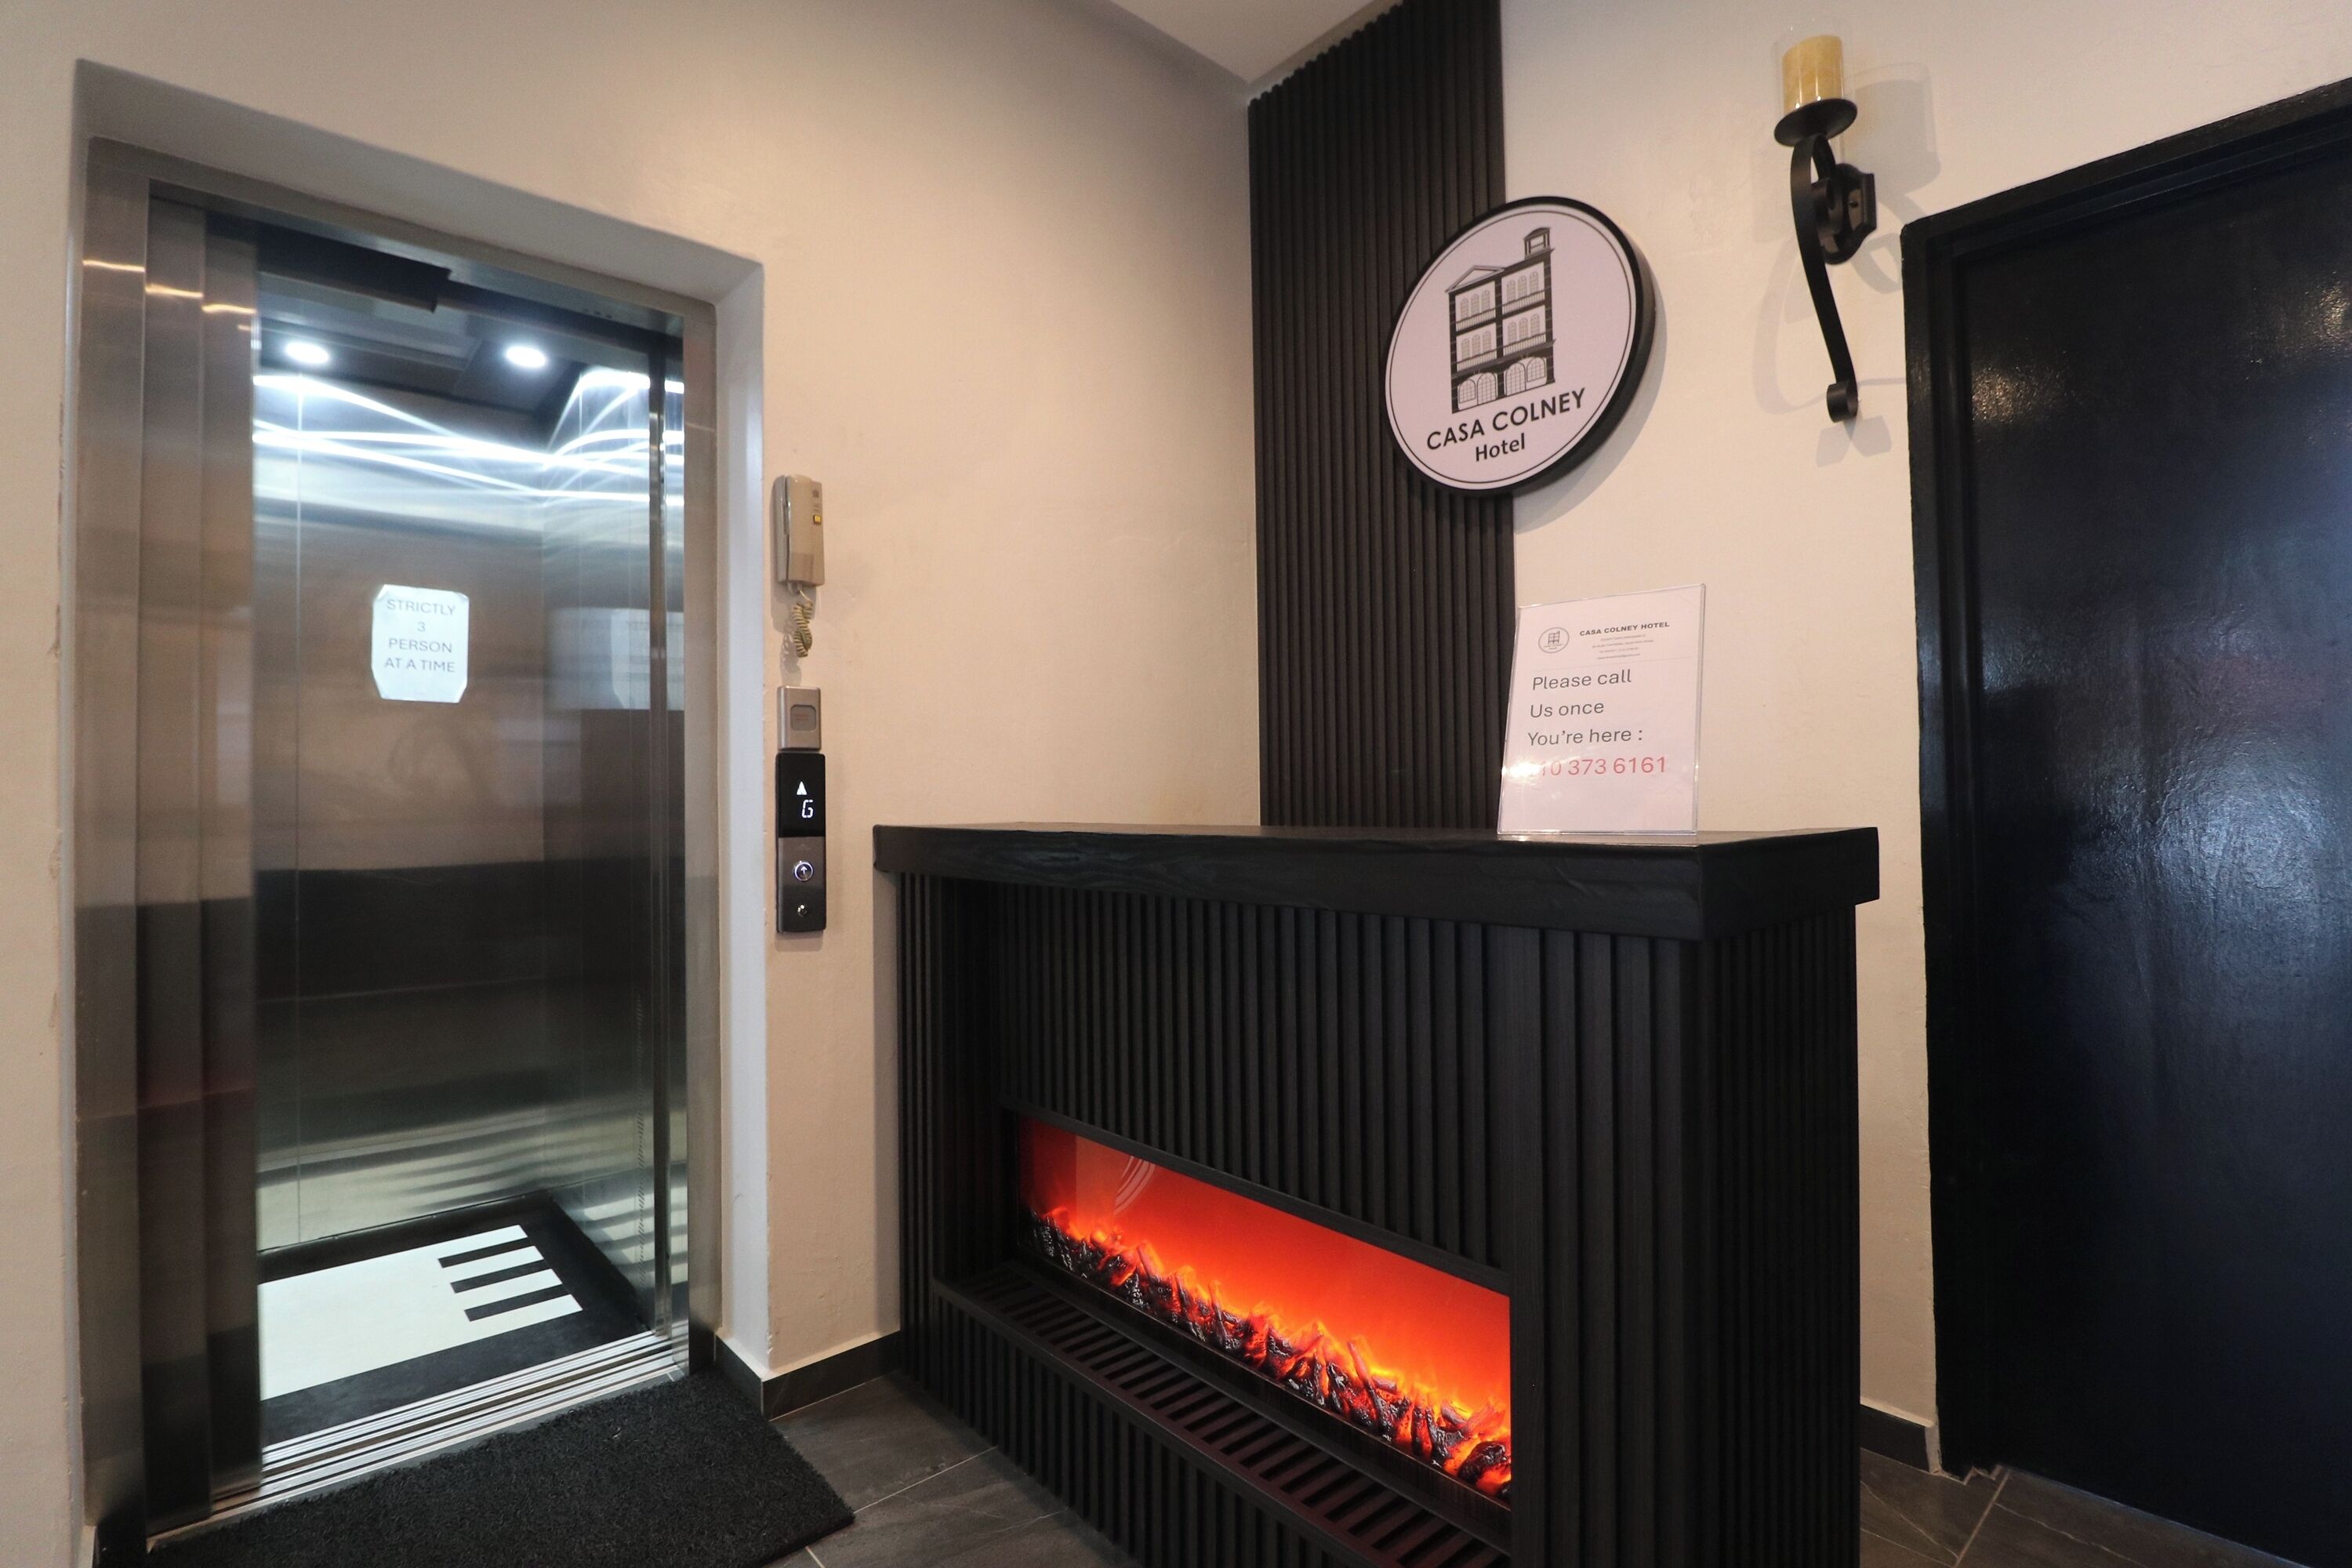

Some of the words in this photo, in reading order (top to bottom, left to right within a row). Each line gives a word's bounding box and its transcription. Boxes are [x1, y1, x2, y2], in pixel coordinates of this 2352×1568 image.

[1426, 418, 1485, 450] CASA
[1492, 387, 1586, 432] COLNEY
[1475, 433, 1526, 462] Hotel
[387, 599, 456, 615] STRICTLY
[416, 621, 426, 633] 3
[1604, 625, 1638, 634] COLNEY
[1641, 622, 1670, 630] HOTEL
[388, 637, 452, 653] PERSON
[384, 657, 402, 669] AT
[406, 659, 417, 670] A
[420, 659, 456, 673] TIME
[1532, 674, 1592, 691] Please
[1597, 669, 1632, 685] call
[1530, 703, 1553, 718] Us
[1559, 702, 1605, 717] once
[1589, 728, 1632, 744] here
[1568, 758, 1606, 775] 373
[1613, 756, 1667, 774] 6161
[801, 799, 814, 818] G
